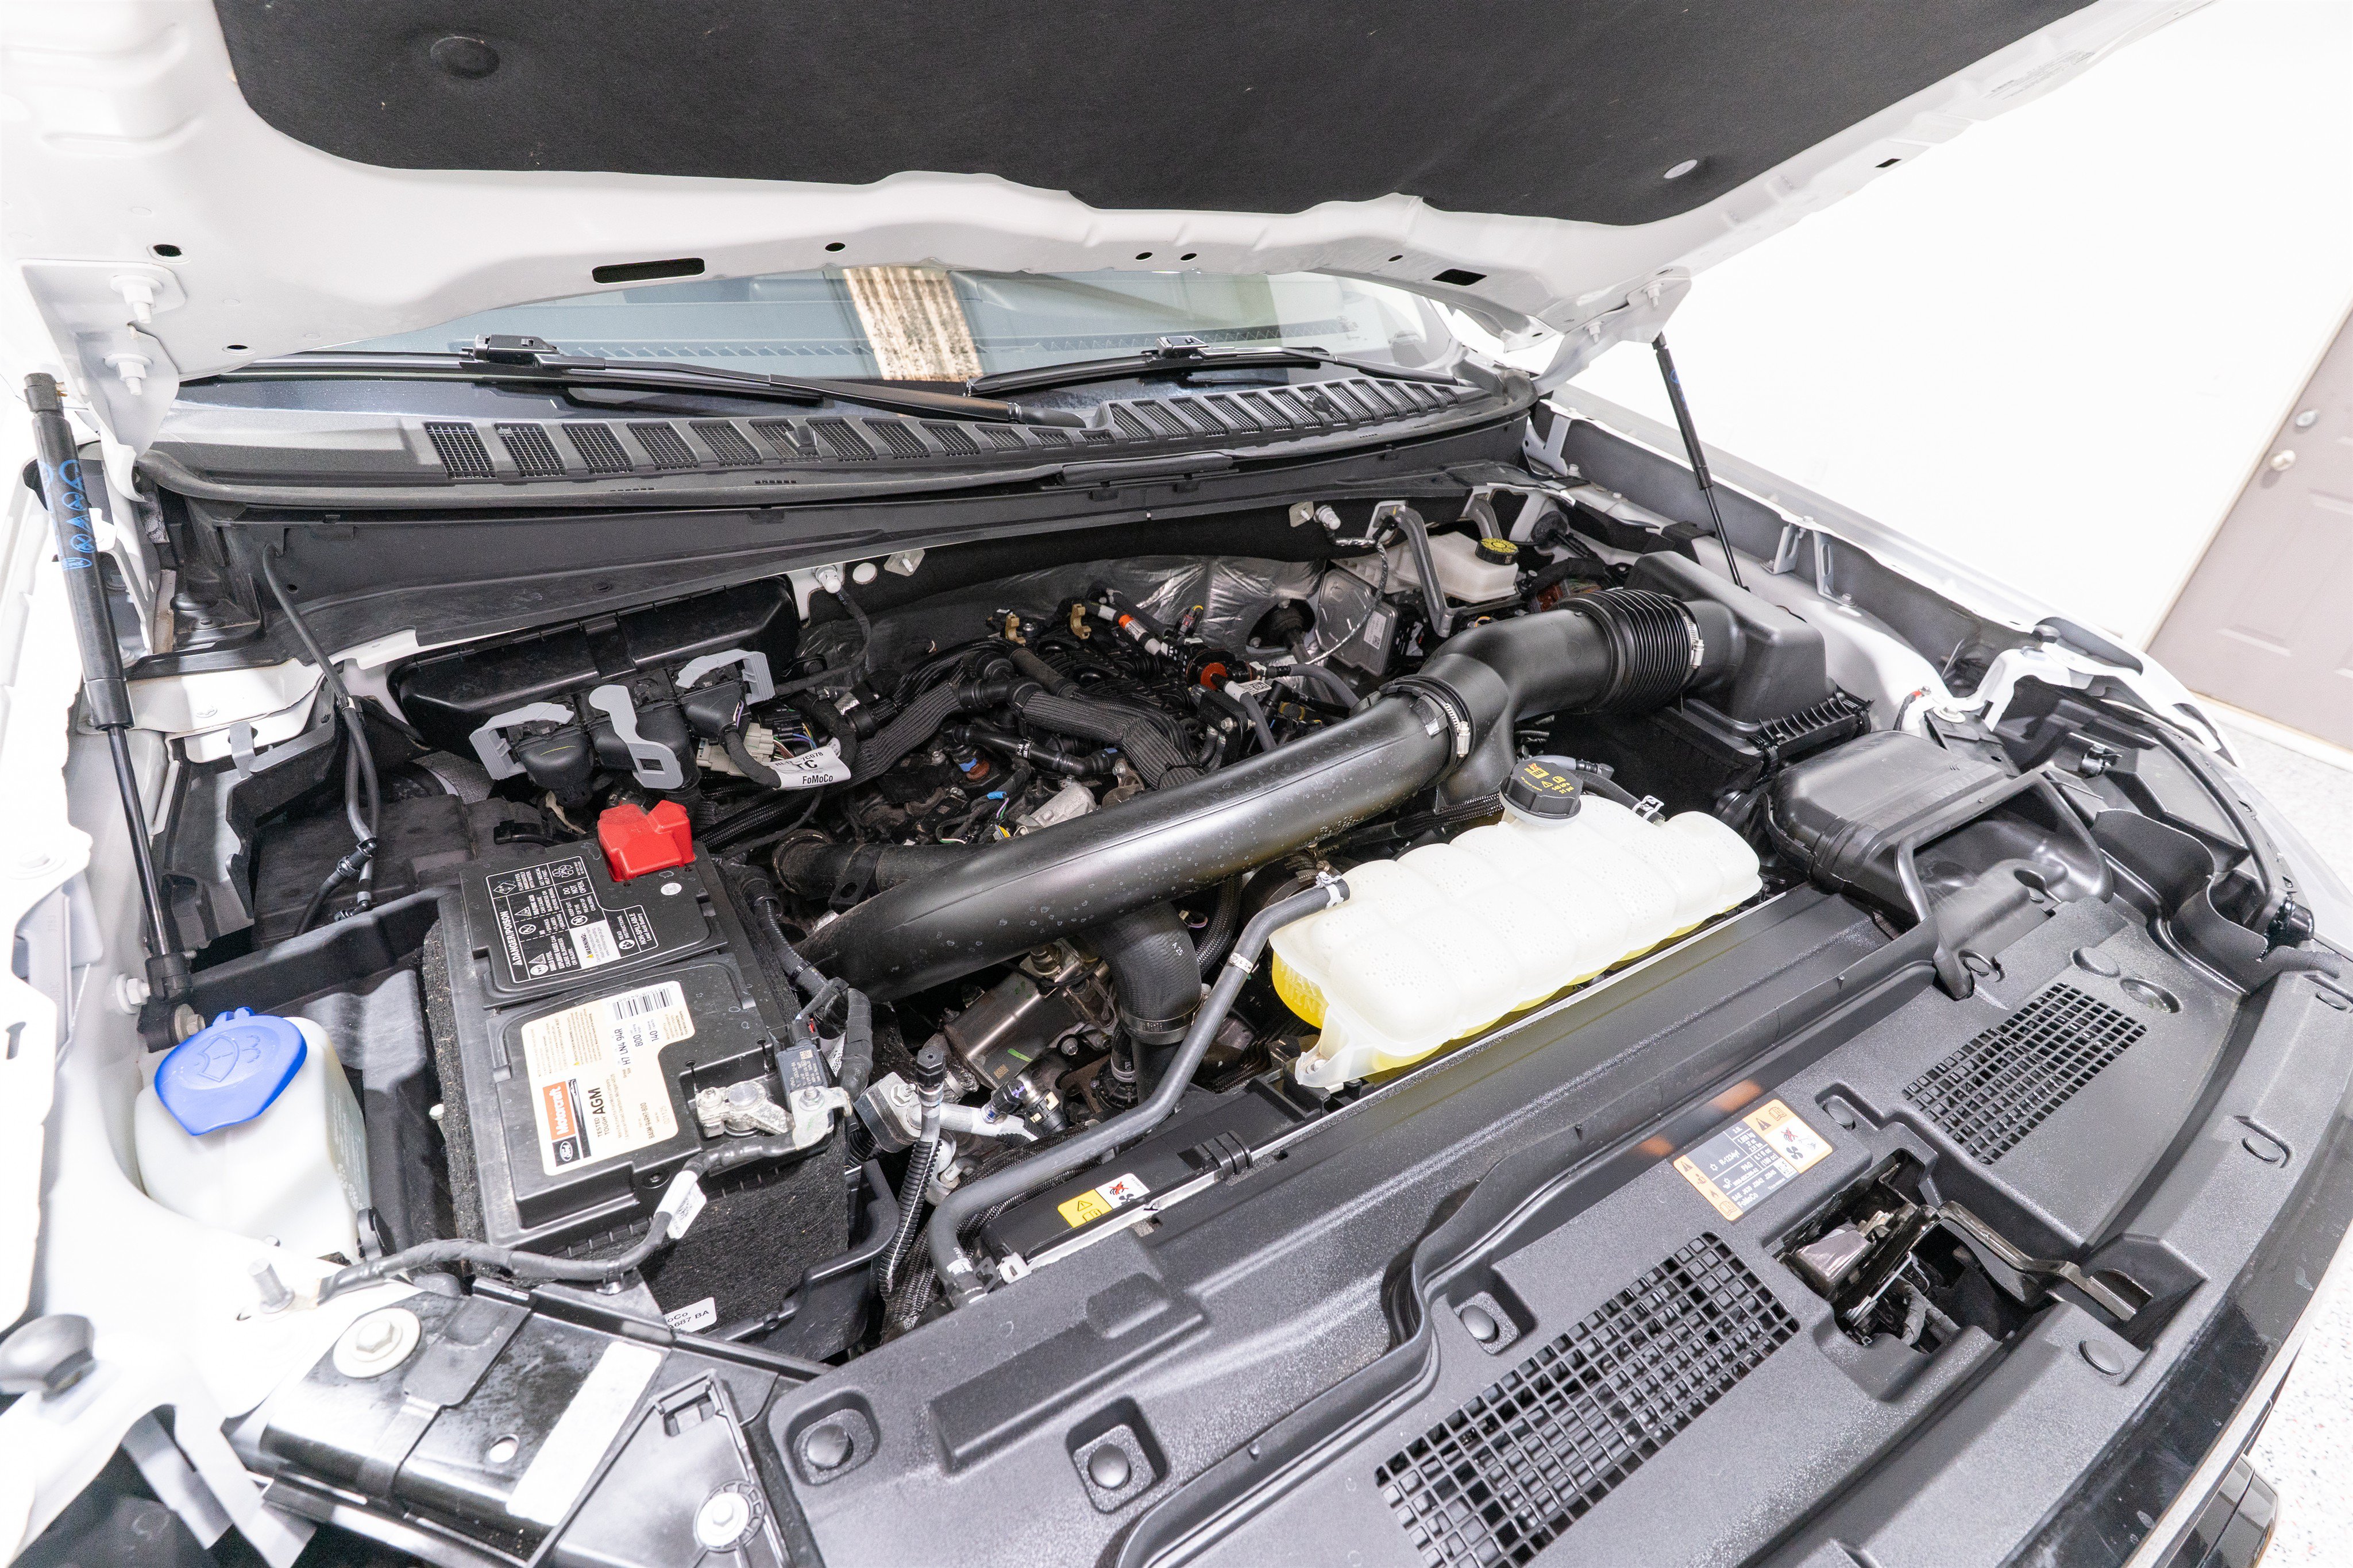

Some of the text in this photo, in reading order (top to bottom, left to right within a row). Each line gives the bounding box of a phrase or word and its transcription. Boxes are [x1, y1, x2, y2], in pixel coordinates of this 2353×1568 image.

[802, 774, 834, 785] FoMoCo
[520, 872, 529, 890] IMMEDIATELY
[577, 880, 586, 893] OPEN.
[570, 885, 578, 894] NOT
[543, 895, 553, 912] BLINDNESS
[543, 919, 551, 931] SPARKS
[550, 917, 558, 929] FLAMES
[557, 914, 565, 928] SMOKING
[618, 916, 630, 939] INSTRUCTIONS.
[500, 911, 520, 960] DANGER/POISON
[629, 913, 646, 945] NON-SPILLABLE
[551, 943, 560, 952] GASES
[581, 934, 592, 955] WARNING:
[558, 938, 571, 967] CAUSE BLINDNESS
[1175, 947, 1183, 956] 25
[548, 960, 557, 971] SHIELD
[555, 952, 565, 969] EXPLOSIVE
[615, 1028, 624, 1041] 94R
[633, 1034, 643, 1046] 800
[650, 1030, 659, 1041] 140
[618, 1042, 628, 1055] LN4
[621, 1057, 631, 1065] H7
[588, 1088, 605, 1114] AGM
[550, 1087, 569, 1134] Motorcraft
[640, 1103, 655, 1138] BAGM-94RH7-800
[594, 1118, 602, 1137] TESTED
[1719, 1150, 1740, 1165] R-1234yf
[1741, 1161, 1753, 1172] PAG
[1731, 1192, 1743, 1201] SAE
[1737, 1193, 1758, 1208] FoMoCo
[665, 1312, 688, 1323] oCo
[695, 1310, 709, 1319] BA
